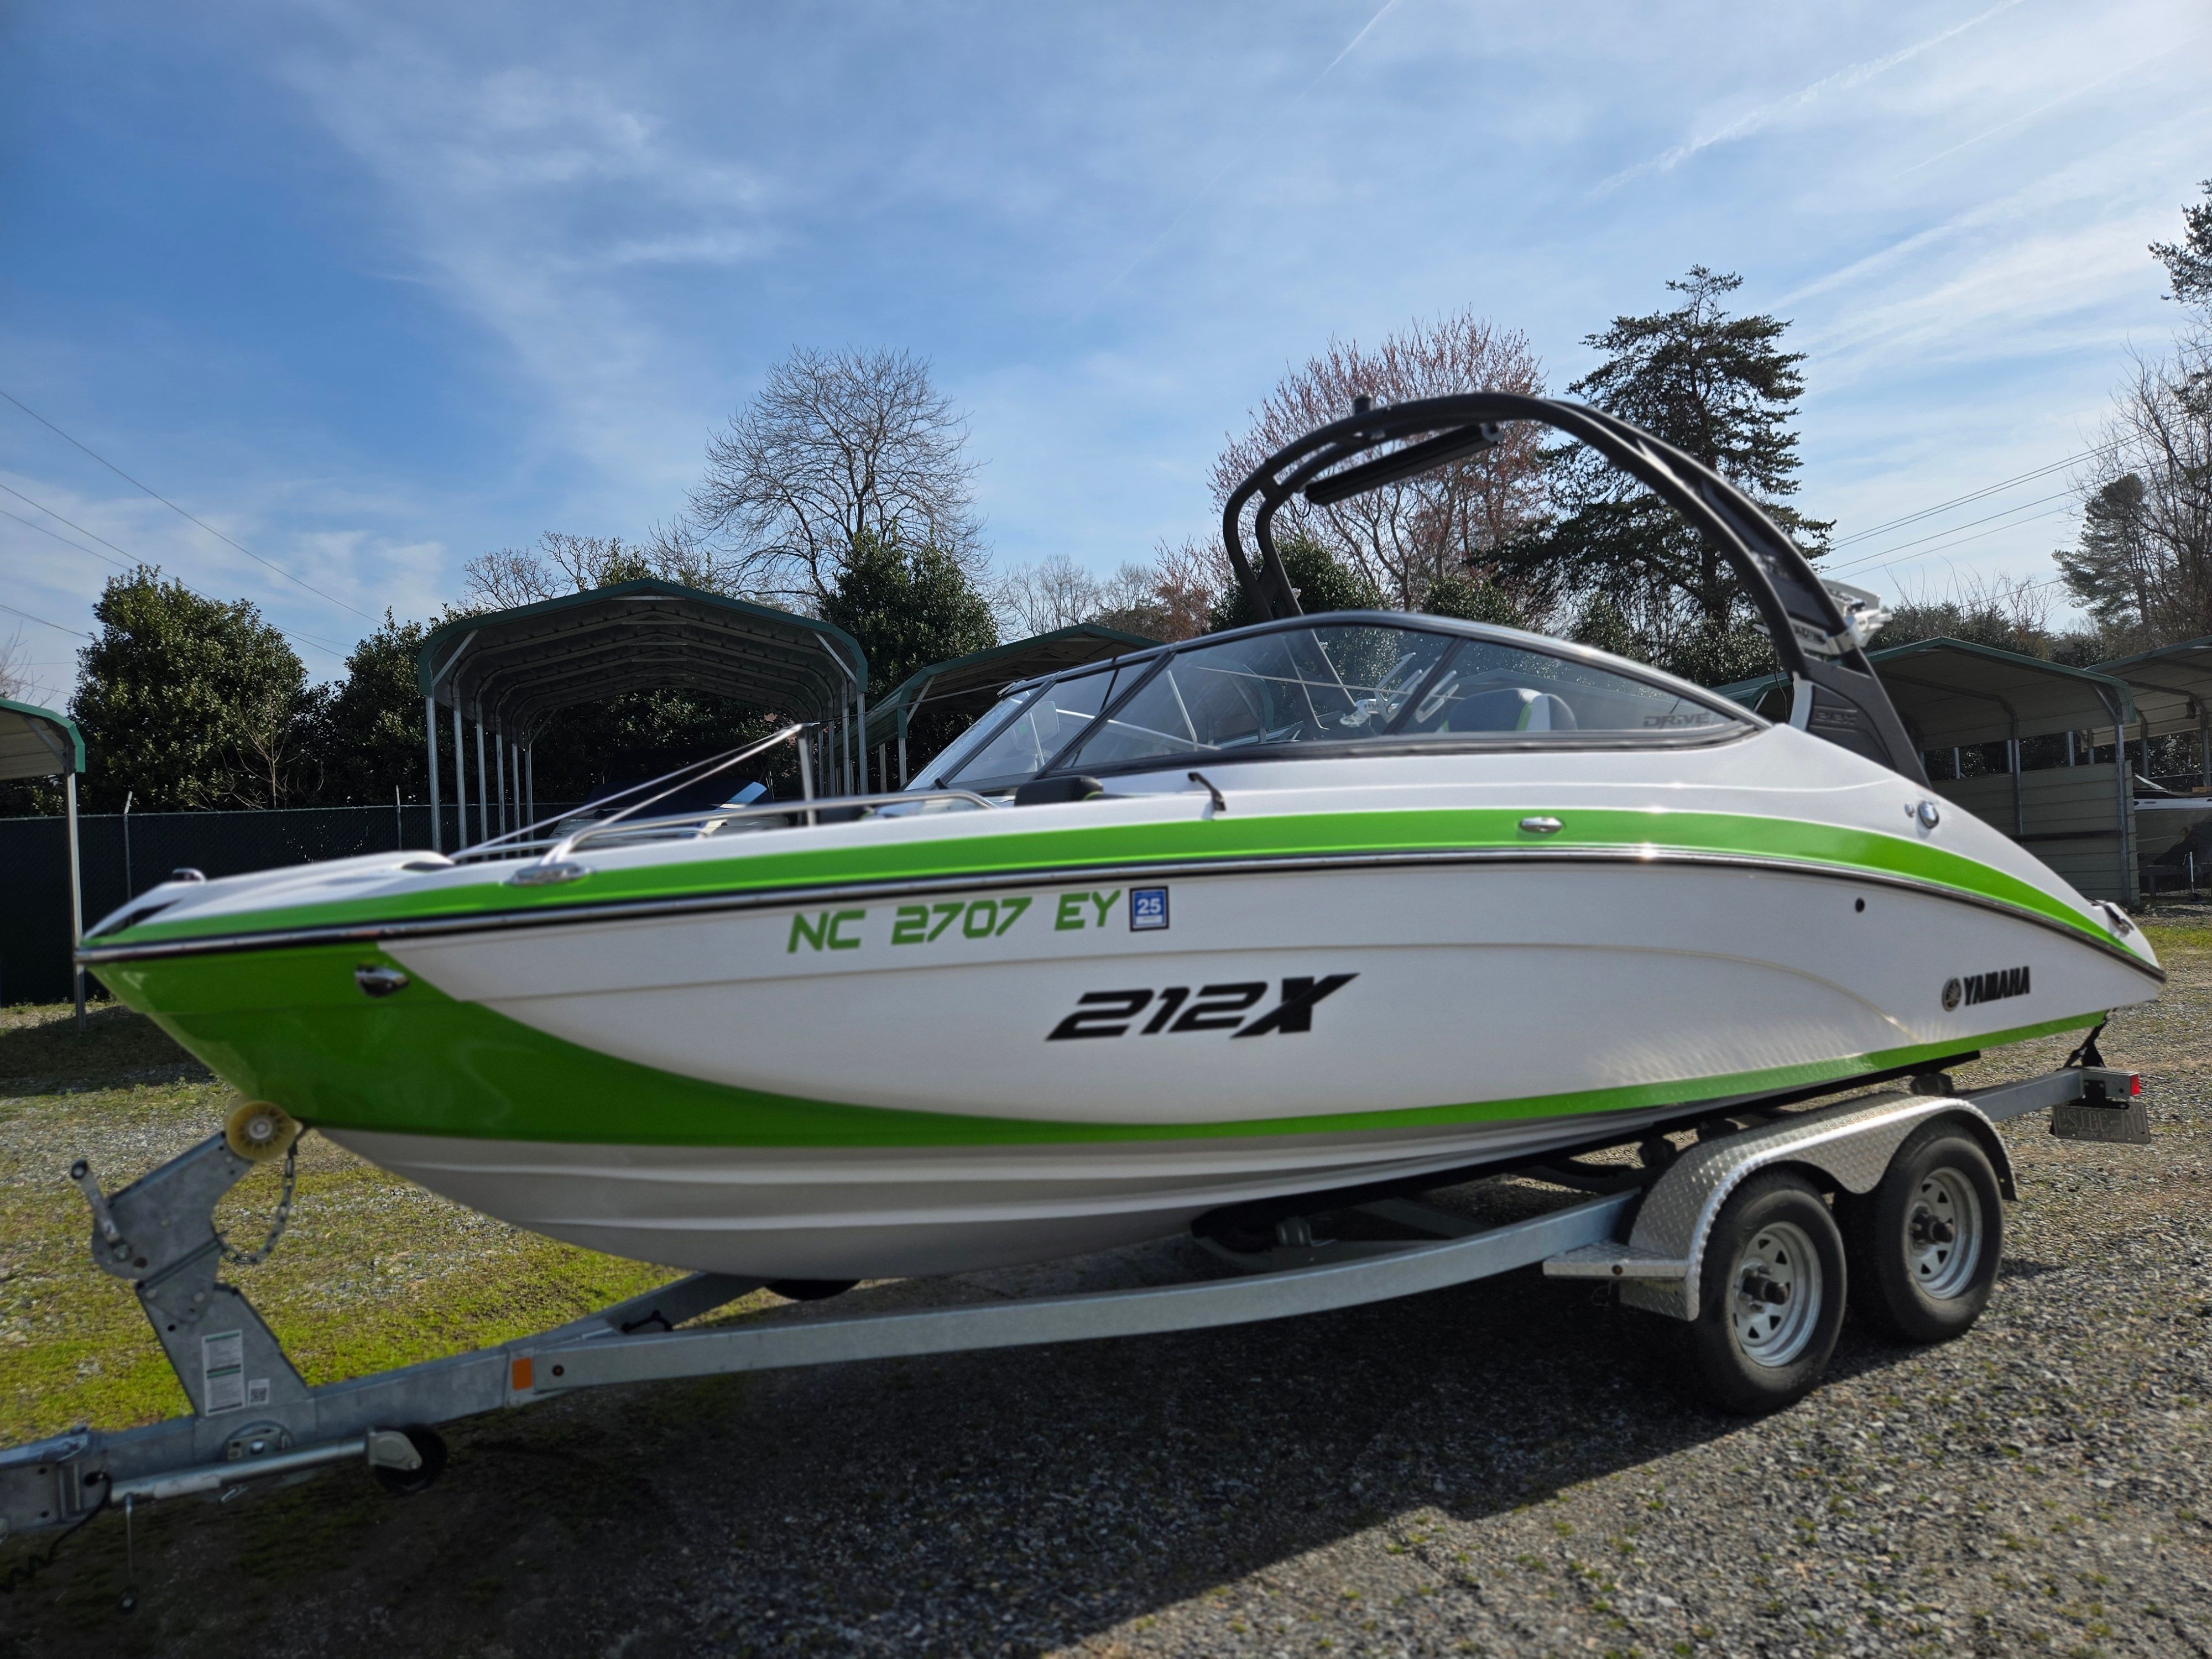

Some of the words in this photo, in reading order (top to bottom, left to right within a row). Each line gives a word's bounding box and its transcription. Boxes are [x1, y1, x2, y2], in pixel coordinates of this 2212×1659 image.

[787, 909, 866, 953] NC
[891, 896, 1032, 945] 2707
[1054, 890, 1121, 930] EY
[1137, 897, 1162, 915] 25
[1045, 972, 1360, 1041] 212X
[1964, 966, 2031, 1006] YAMAHA
